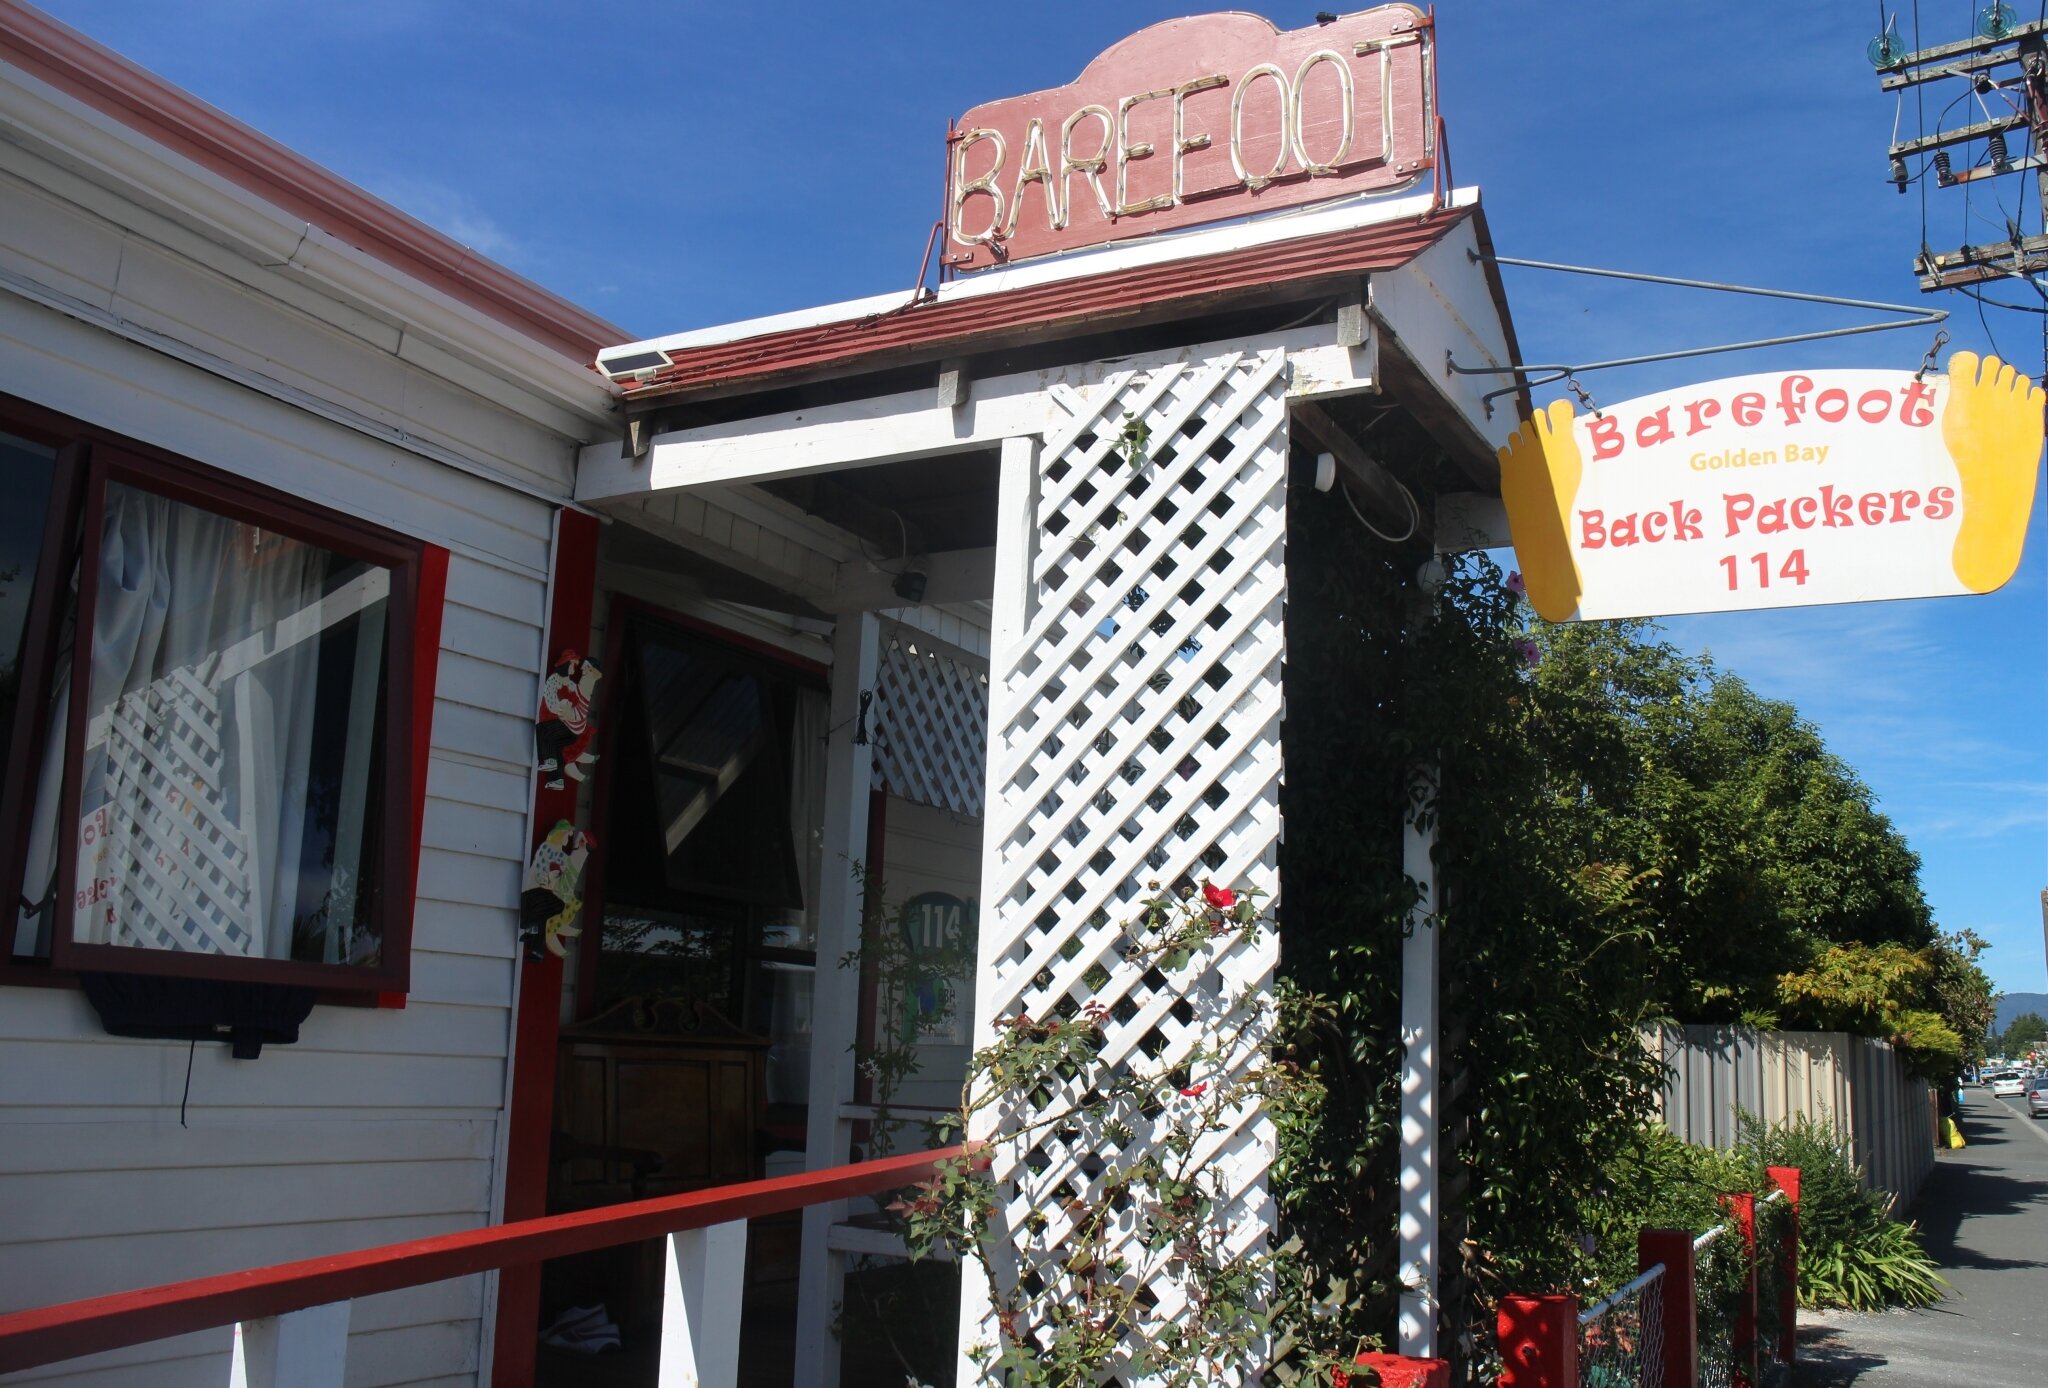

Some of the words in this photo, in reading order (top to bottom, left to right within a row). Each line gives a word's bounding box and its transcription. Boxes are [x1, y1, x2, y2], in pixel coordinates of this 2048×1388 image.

[953, 32, 1420, 244] BAREFOOT
[1586, 376, 1935, 461] Barefoot
[1690, 447, 1777, 472] Golden
[1785, 443, 1829, 465] Bay
[1580, 500, 1703, 549] Back
[1724, 485, 1954, 537] Packers
[1720, 549, 1809, 591] 114
[922, 904, 962, 951] 114
